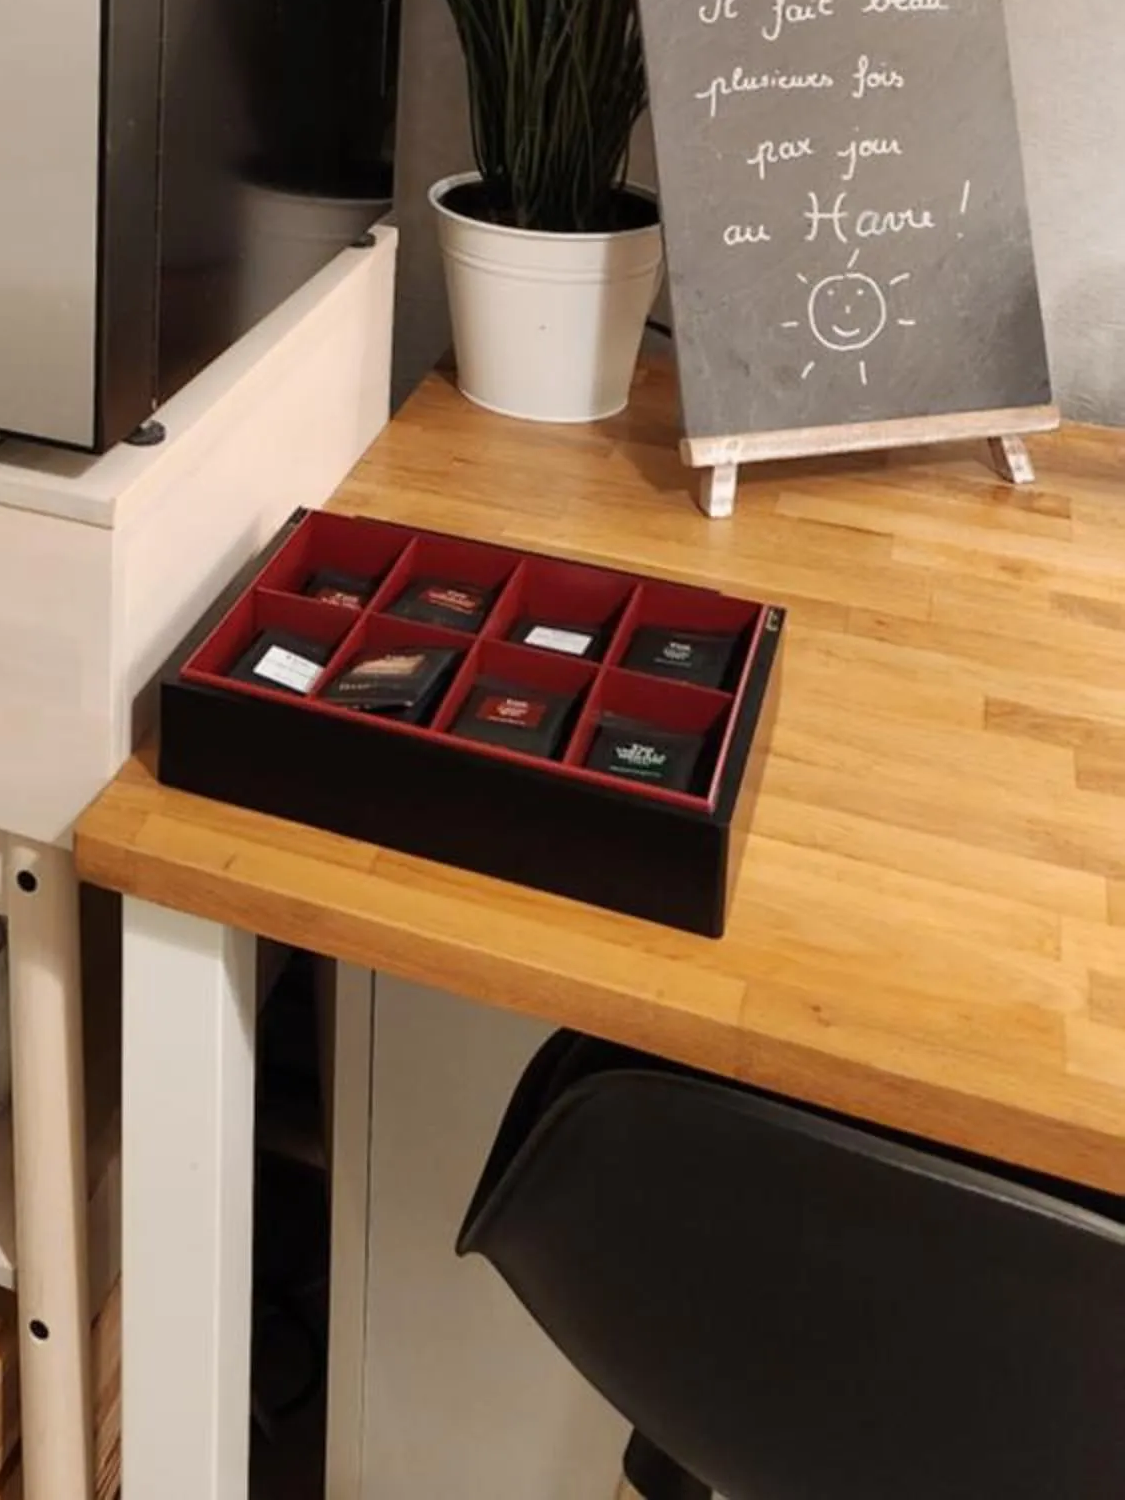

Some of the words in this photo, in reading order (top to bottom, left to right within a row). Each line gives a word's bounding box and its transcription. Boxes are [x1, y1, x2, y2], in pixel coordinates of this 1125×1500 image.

[695, 67, 835, 117] plusieurs
[851, 54, 905, 99] fois
[746, 136, 814, 180] par
[837, 127, 903, 181] jour
[723, 222, 771, 246] au
